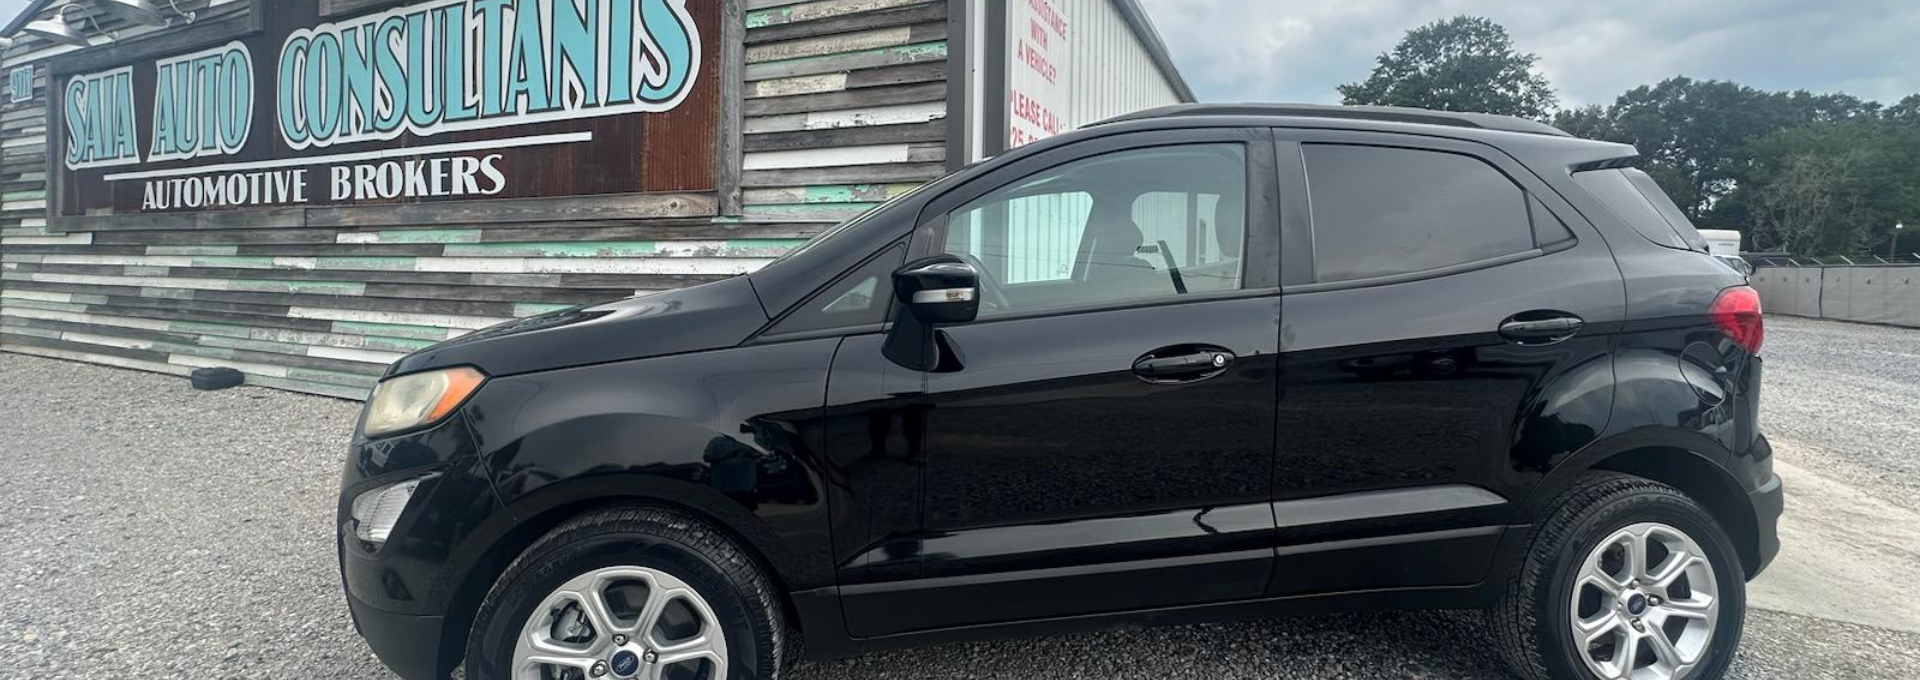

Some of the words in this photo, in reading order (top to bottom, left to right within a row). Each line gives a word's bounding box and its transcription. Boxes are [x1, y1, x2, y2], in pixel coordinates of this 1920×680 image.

[66, 67, 139, 169] SAIA
[148, 42, 253, 161] AUTO
[278, 0, 700, 149] CONSULTANTS
[1018, 38, 1023, 61] A
[1026, 44, 1056, 85] VEHICLE?
[142, 169, 307, 210] AUTOMOTIVE
[330, 154, 506, 202] BROKERS
